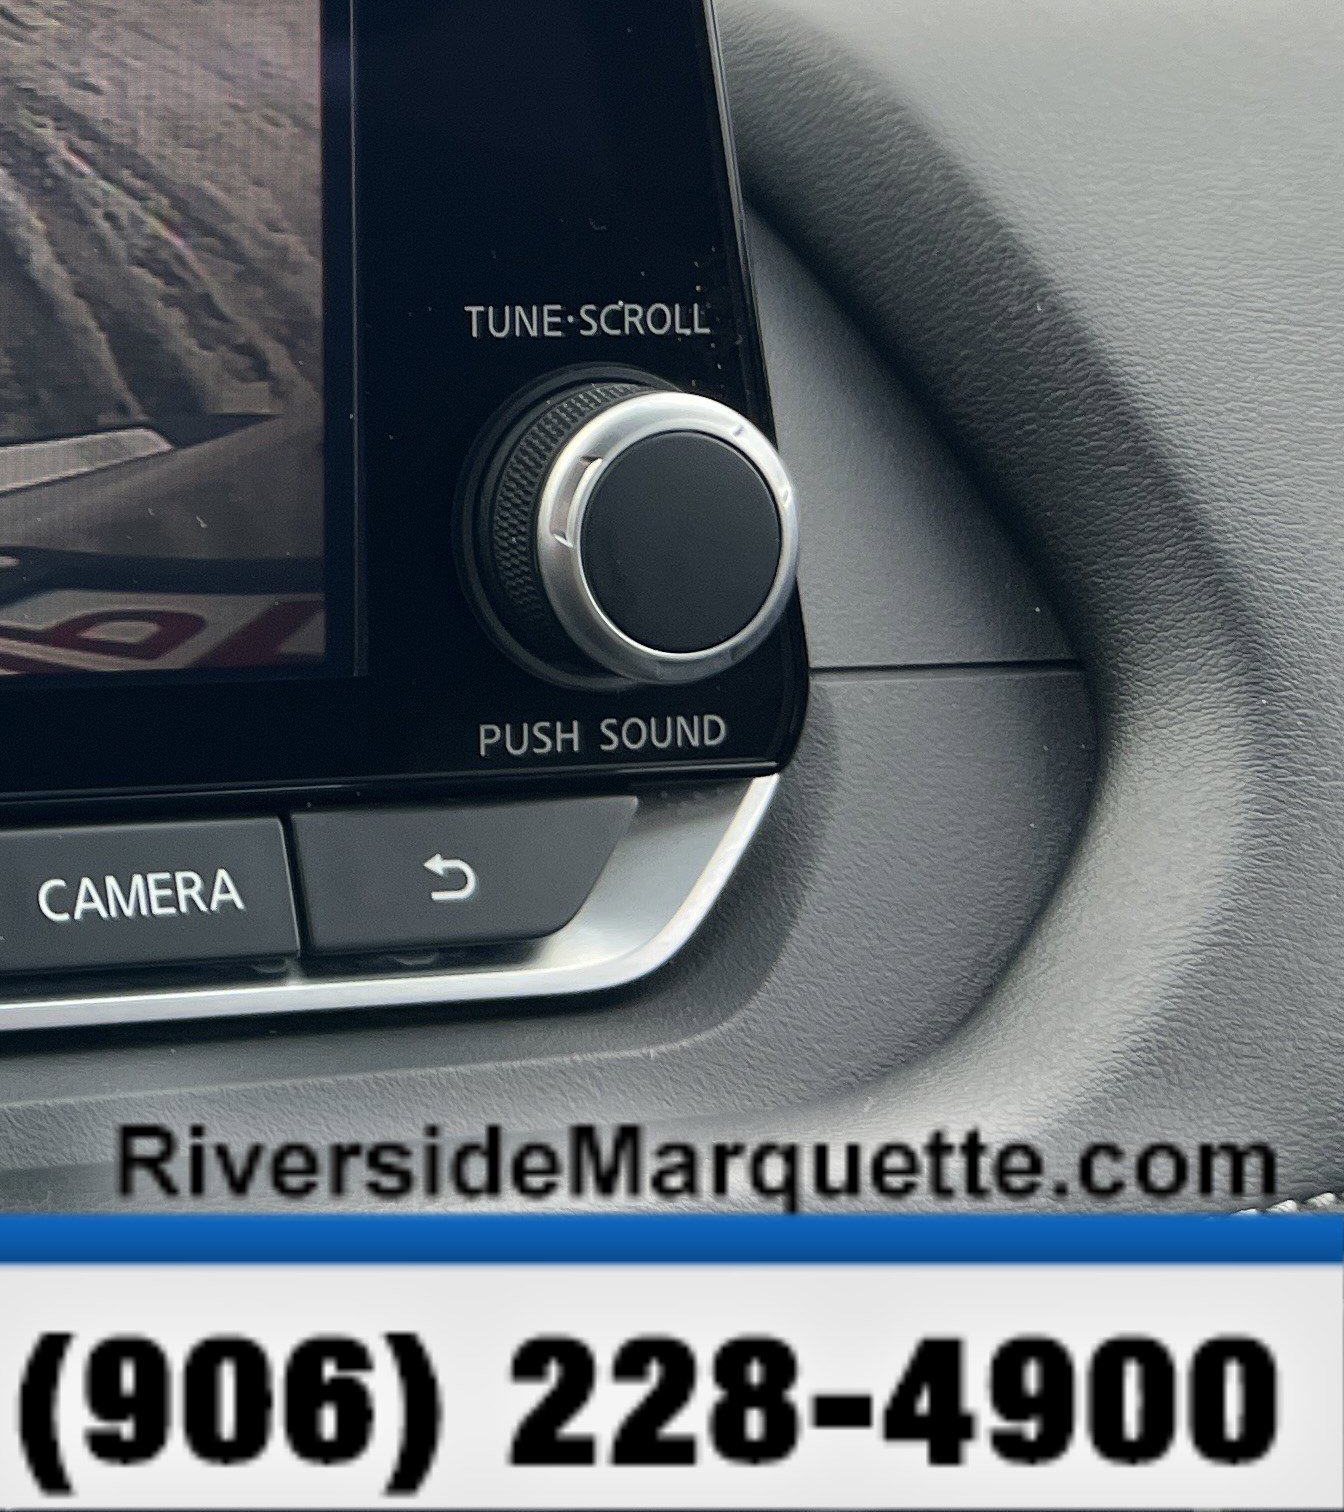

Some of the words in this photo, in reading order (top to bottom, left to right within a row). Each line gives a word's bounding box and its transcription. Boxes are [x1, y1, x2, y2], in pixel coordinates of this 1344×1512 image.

[479, 722, 580, 756] PUSH
[600, 714, 727, 751] SOUND
[38, 868, 245, 922] CAMERA
